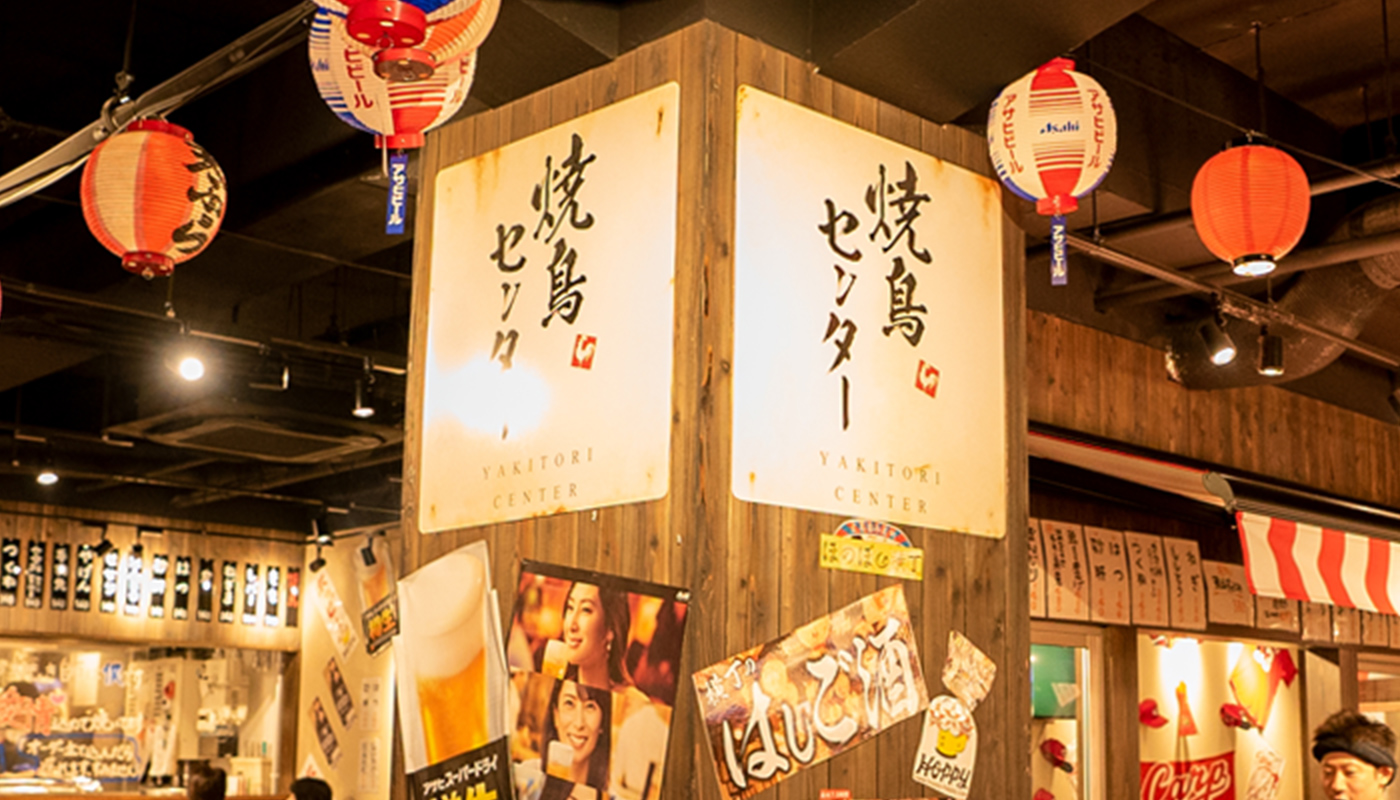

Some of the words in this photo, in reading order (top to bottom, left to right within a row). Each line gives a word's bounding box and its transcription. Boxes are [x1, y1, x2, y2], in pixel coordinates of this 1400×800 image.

[1003, 94, 1024, 175] アサヒビール
[1040, 120, 1080, 135] Asahi
[1088, 89, 1105, 169] アサヒビール
[531, 132, 597, 328] 焼鳥
[865, 160, 932, 347] 焼鳥
[818, 198, 862, 431] センター
[482, 447, 593, 480] YAKITORI
[819, 450, 940, 486] YAKITORI
[493, 483, 578, 510] CENTER
[834, 486, 927, 514] CENTER
[175, 560, 191, 595] はつ
[1109, 541, 1124, 582] はつ
[721, 616, 919, 790] はしご酒
